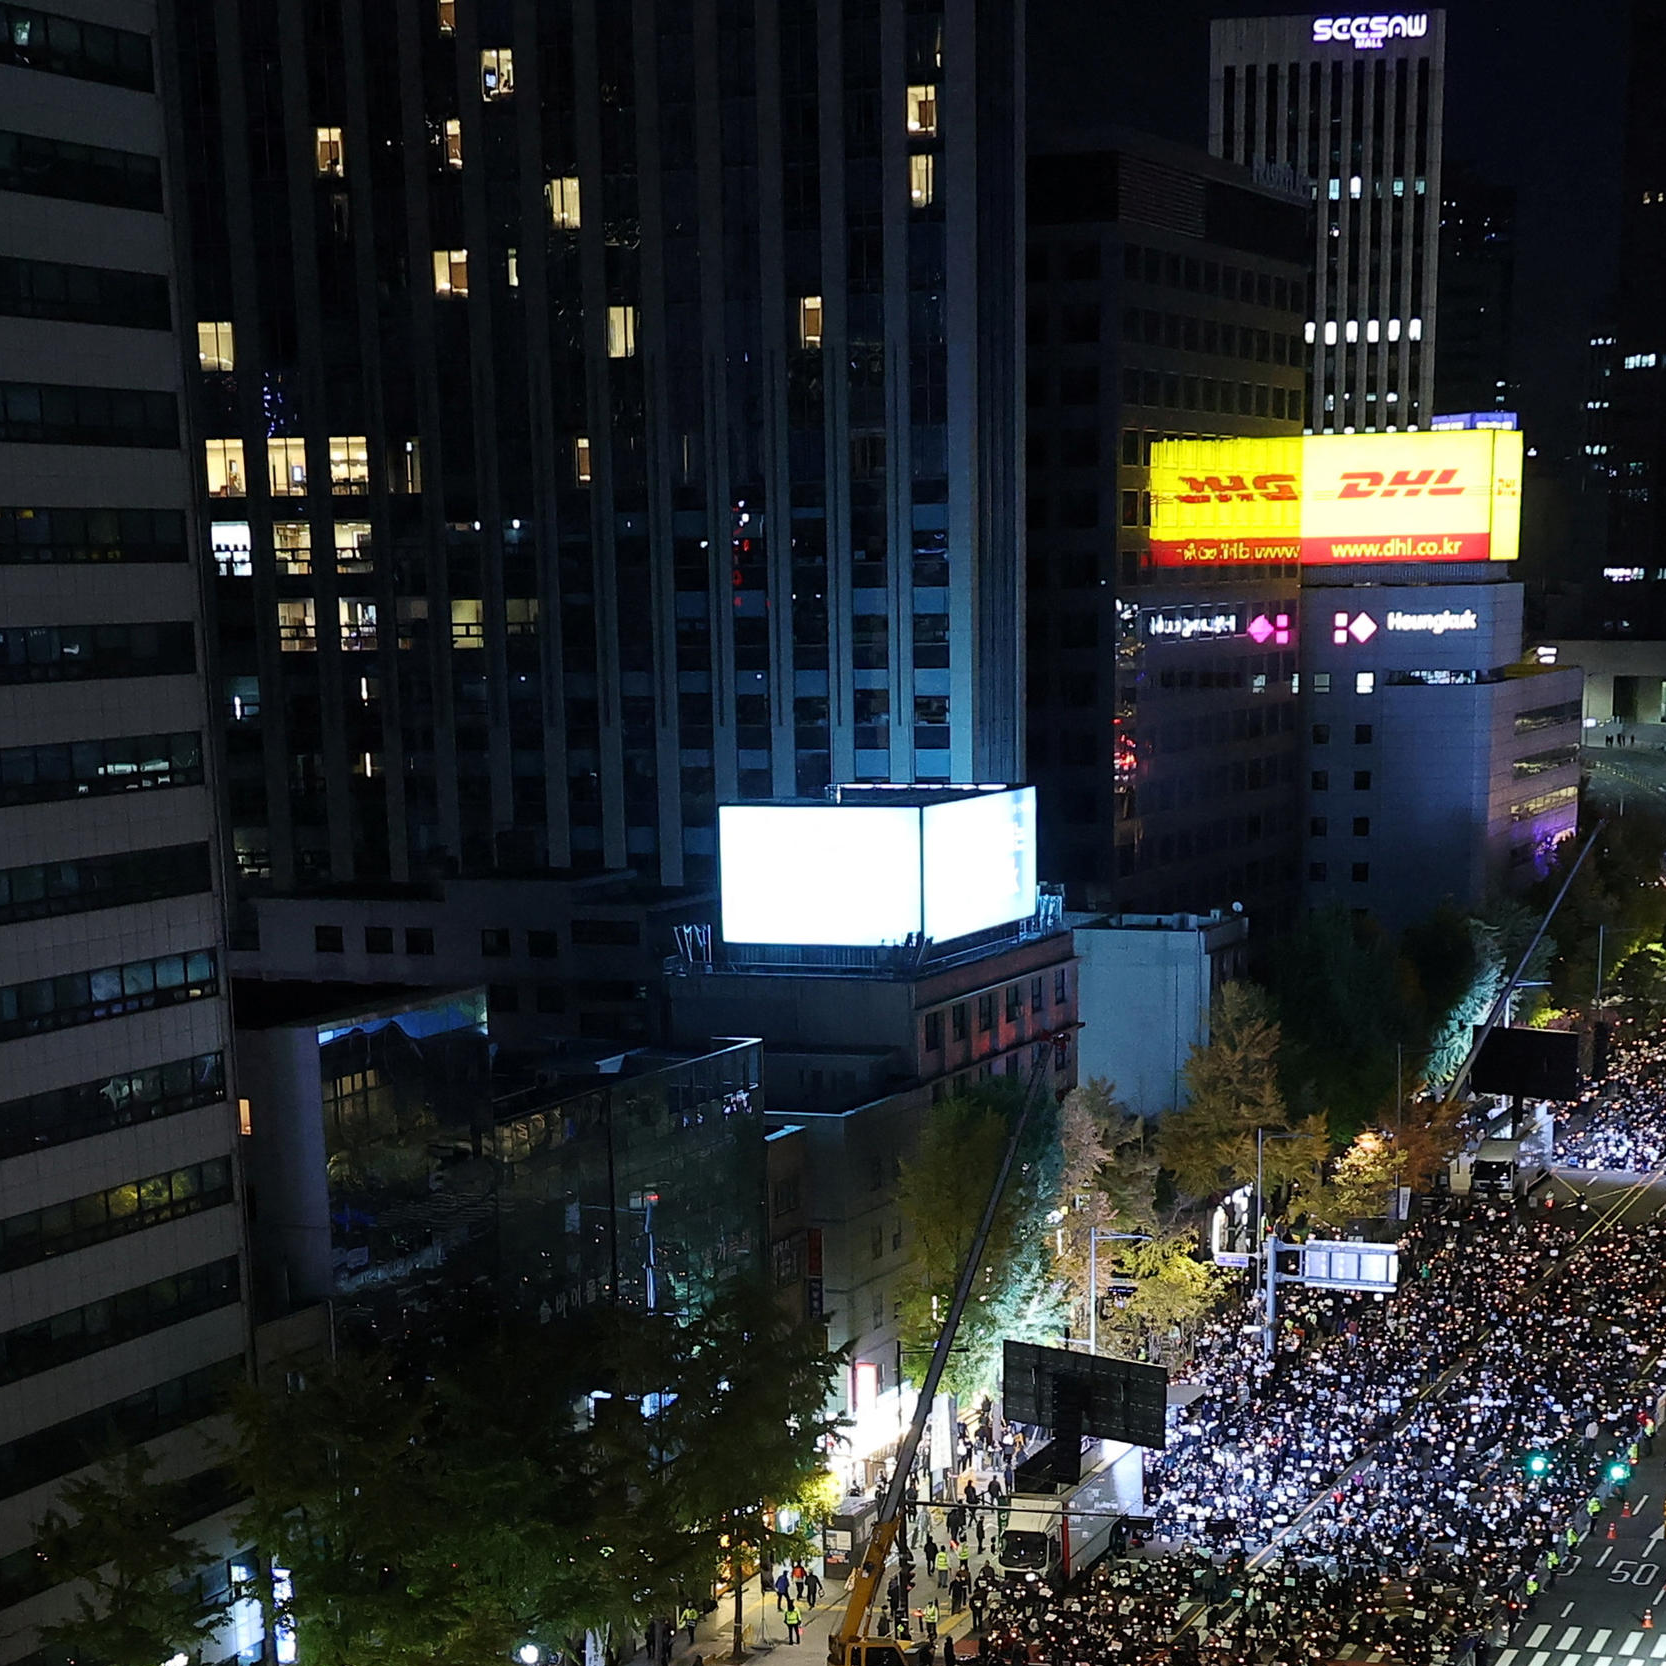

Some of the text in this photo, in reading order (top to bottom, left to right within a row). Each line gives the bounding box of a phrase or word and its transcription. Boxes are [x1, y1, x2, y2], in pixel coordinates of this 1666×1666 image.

[1313, 14, 1428, 41] SEESAW
[1355, 38, 1383, 49] MALL
[1337, 468, 1467, 499] DHL
[1331, 537, 1463, 559] www.dhl.co.kr
[1386, 609, 1478, 635] Heungkuk
